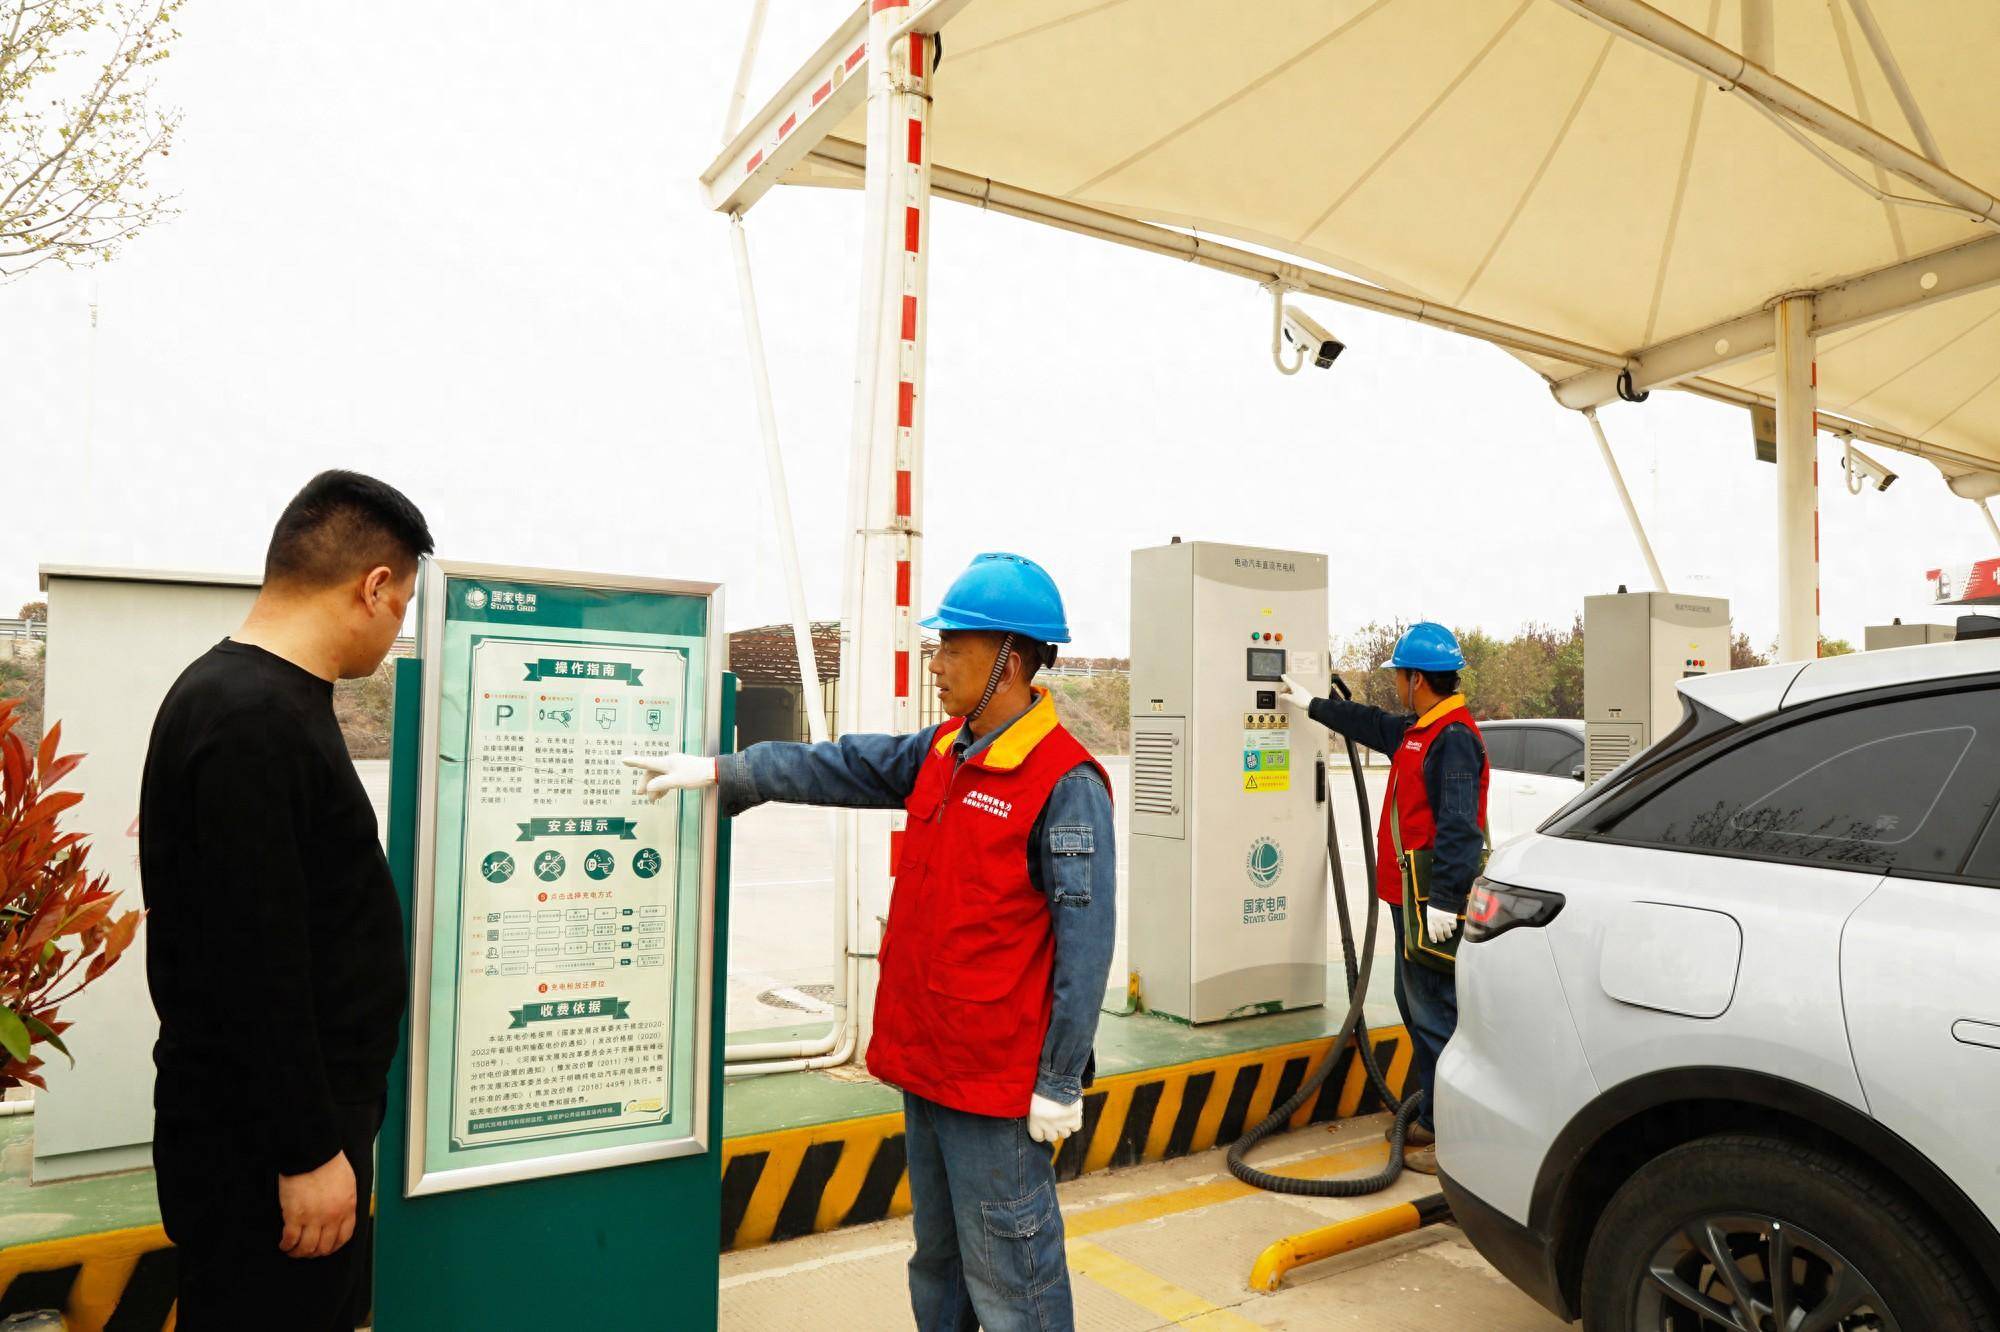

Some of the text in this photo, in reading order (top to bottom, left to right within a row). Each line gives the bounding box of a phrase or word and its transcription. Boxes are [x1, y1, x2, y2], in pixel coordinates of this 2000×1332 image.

[491, 590, 537, 606] 国家电网
[490, 602, 537, 612] STATE GRID
[554, 660, 616, 677] 操作指南
[547, 819, 609, 832] 安全提示
[551, 890, 613, 901] 点击选择充电方式
[1243, 896, 1287, 914] 国家电网
[1243, 912, 1286, 924] STATE GRID
[540, 1001, 601, 1018] 收费依据
